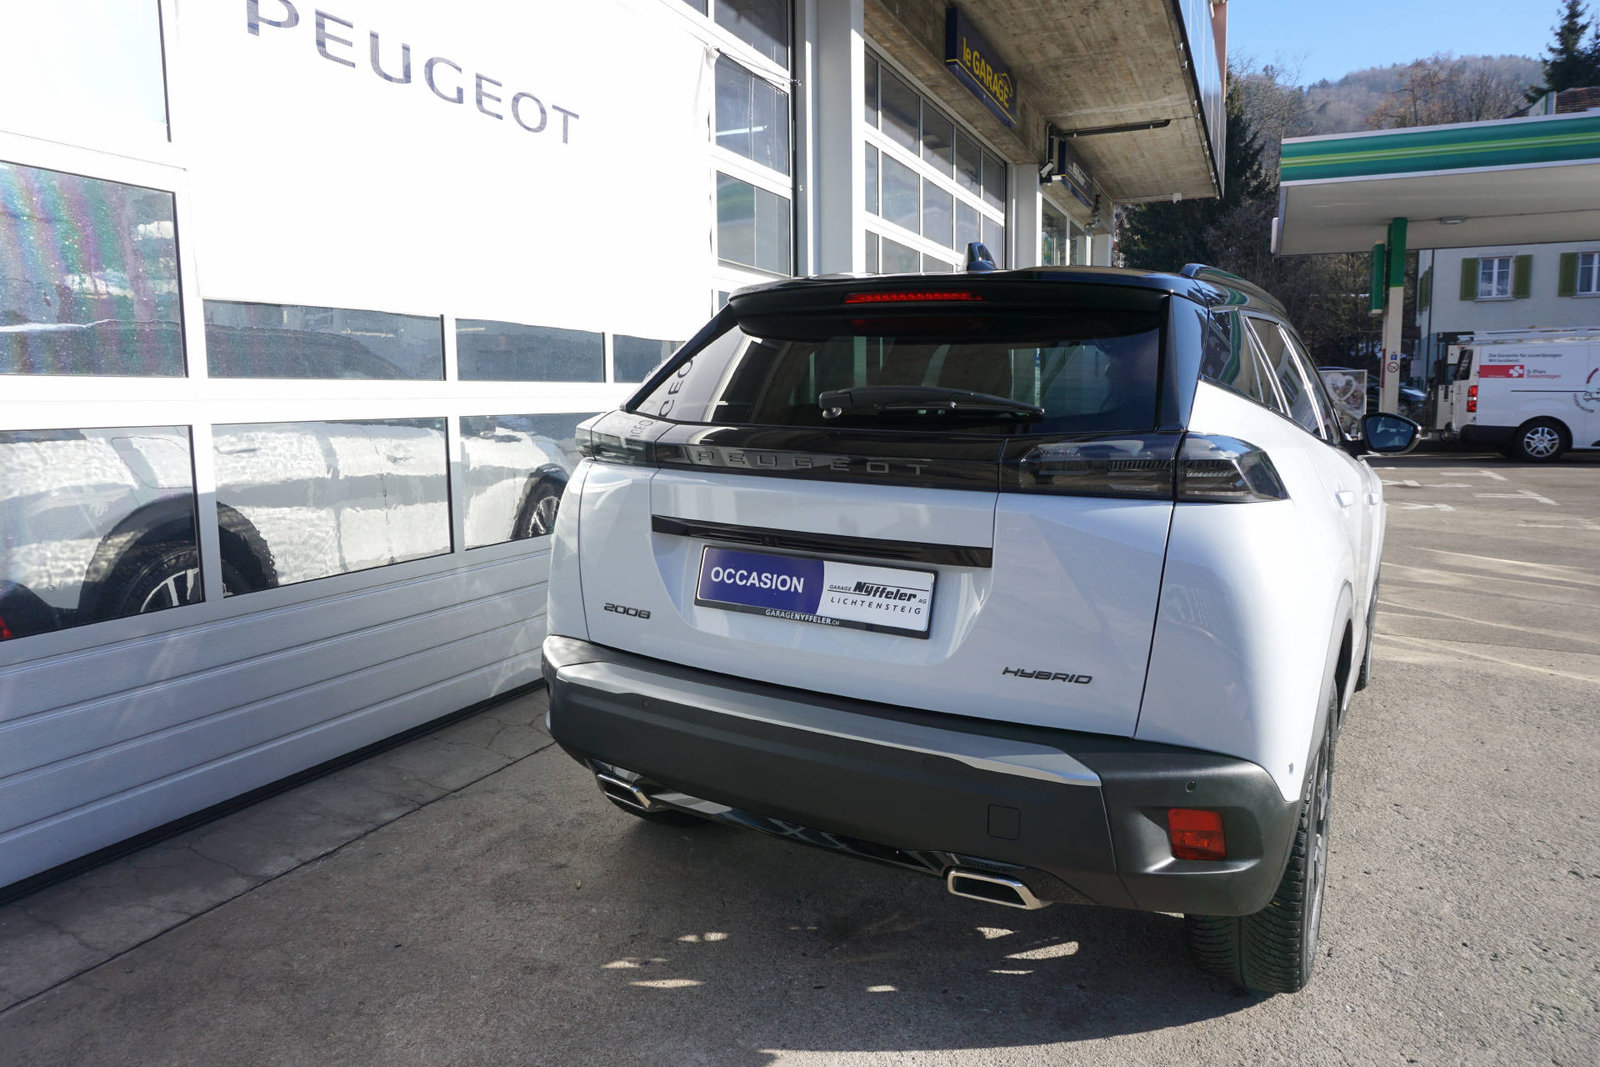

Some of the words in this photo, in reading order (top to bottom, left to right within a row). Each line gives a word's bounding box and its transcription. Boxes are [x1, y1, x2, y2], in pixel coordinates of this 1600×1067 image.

[246, 0, 580, 145] PEUGEOT
[963, 37, 972, 68] le
[972, 51, 1010, 109] GARAGE
[697, 450, 930, 475] PEUGEOT
[711, 566, 805, 593] OCCASION
[829, 584, 852, 593] GARAGE
[853, 581, 917, 602] Nyffeler
[604, 602, 651, 620] 2008
[830, 596, 922, 615] LICHTENSTEIG
[1002, 666, 1093, 685] HYBRID
